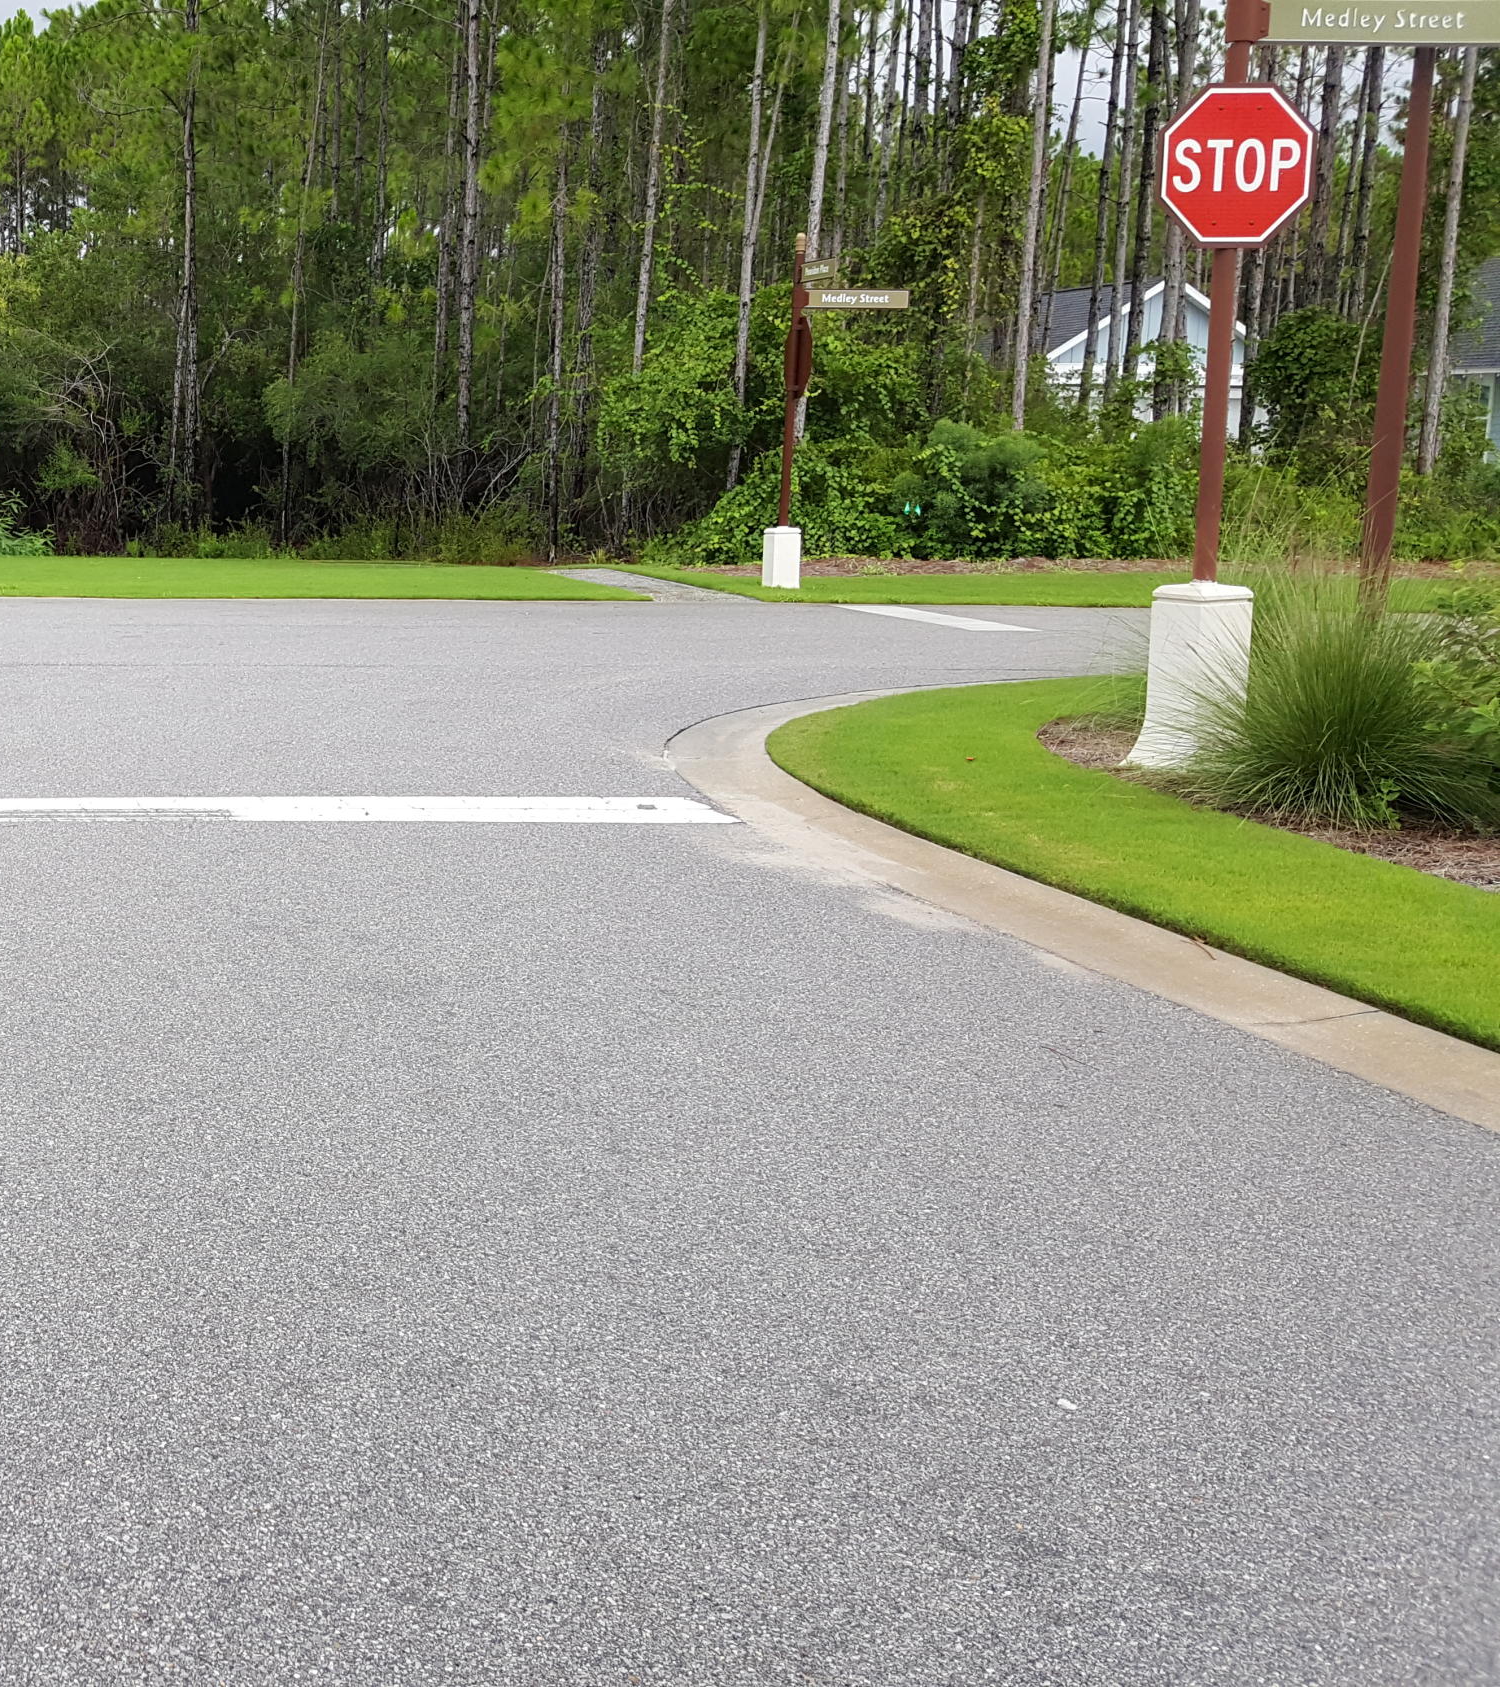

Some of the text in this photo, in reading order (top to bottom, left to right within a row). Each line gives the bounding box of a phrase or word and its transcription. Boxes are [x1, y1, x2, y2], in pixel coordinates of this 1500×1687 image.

[1301, 8, 1466, 33] Medley Street
[1172, 138, 1301, 193] STOP
[822, 293, 889, 305] Medley Street
